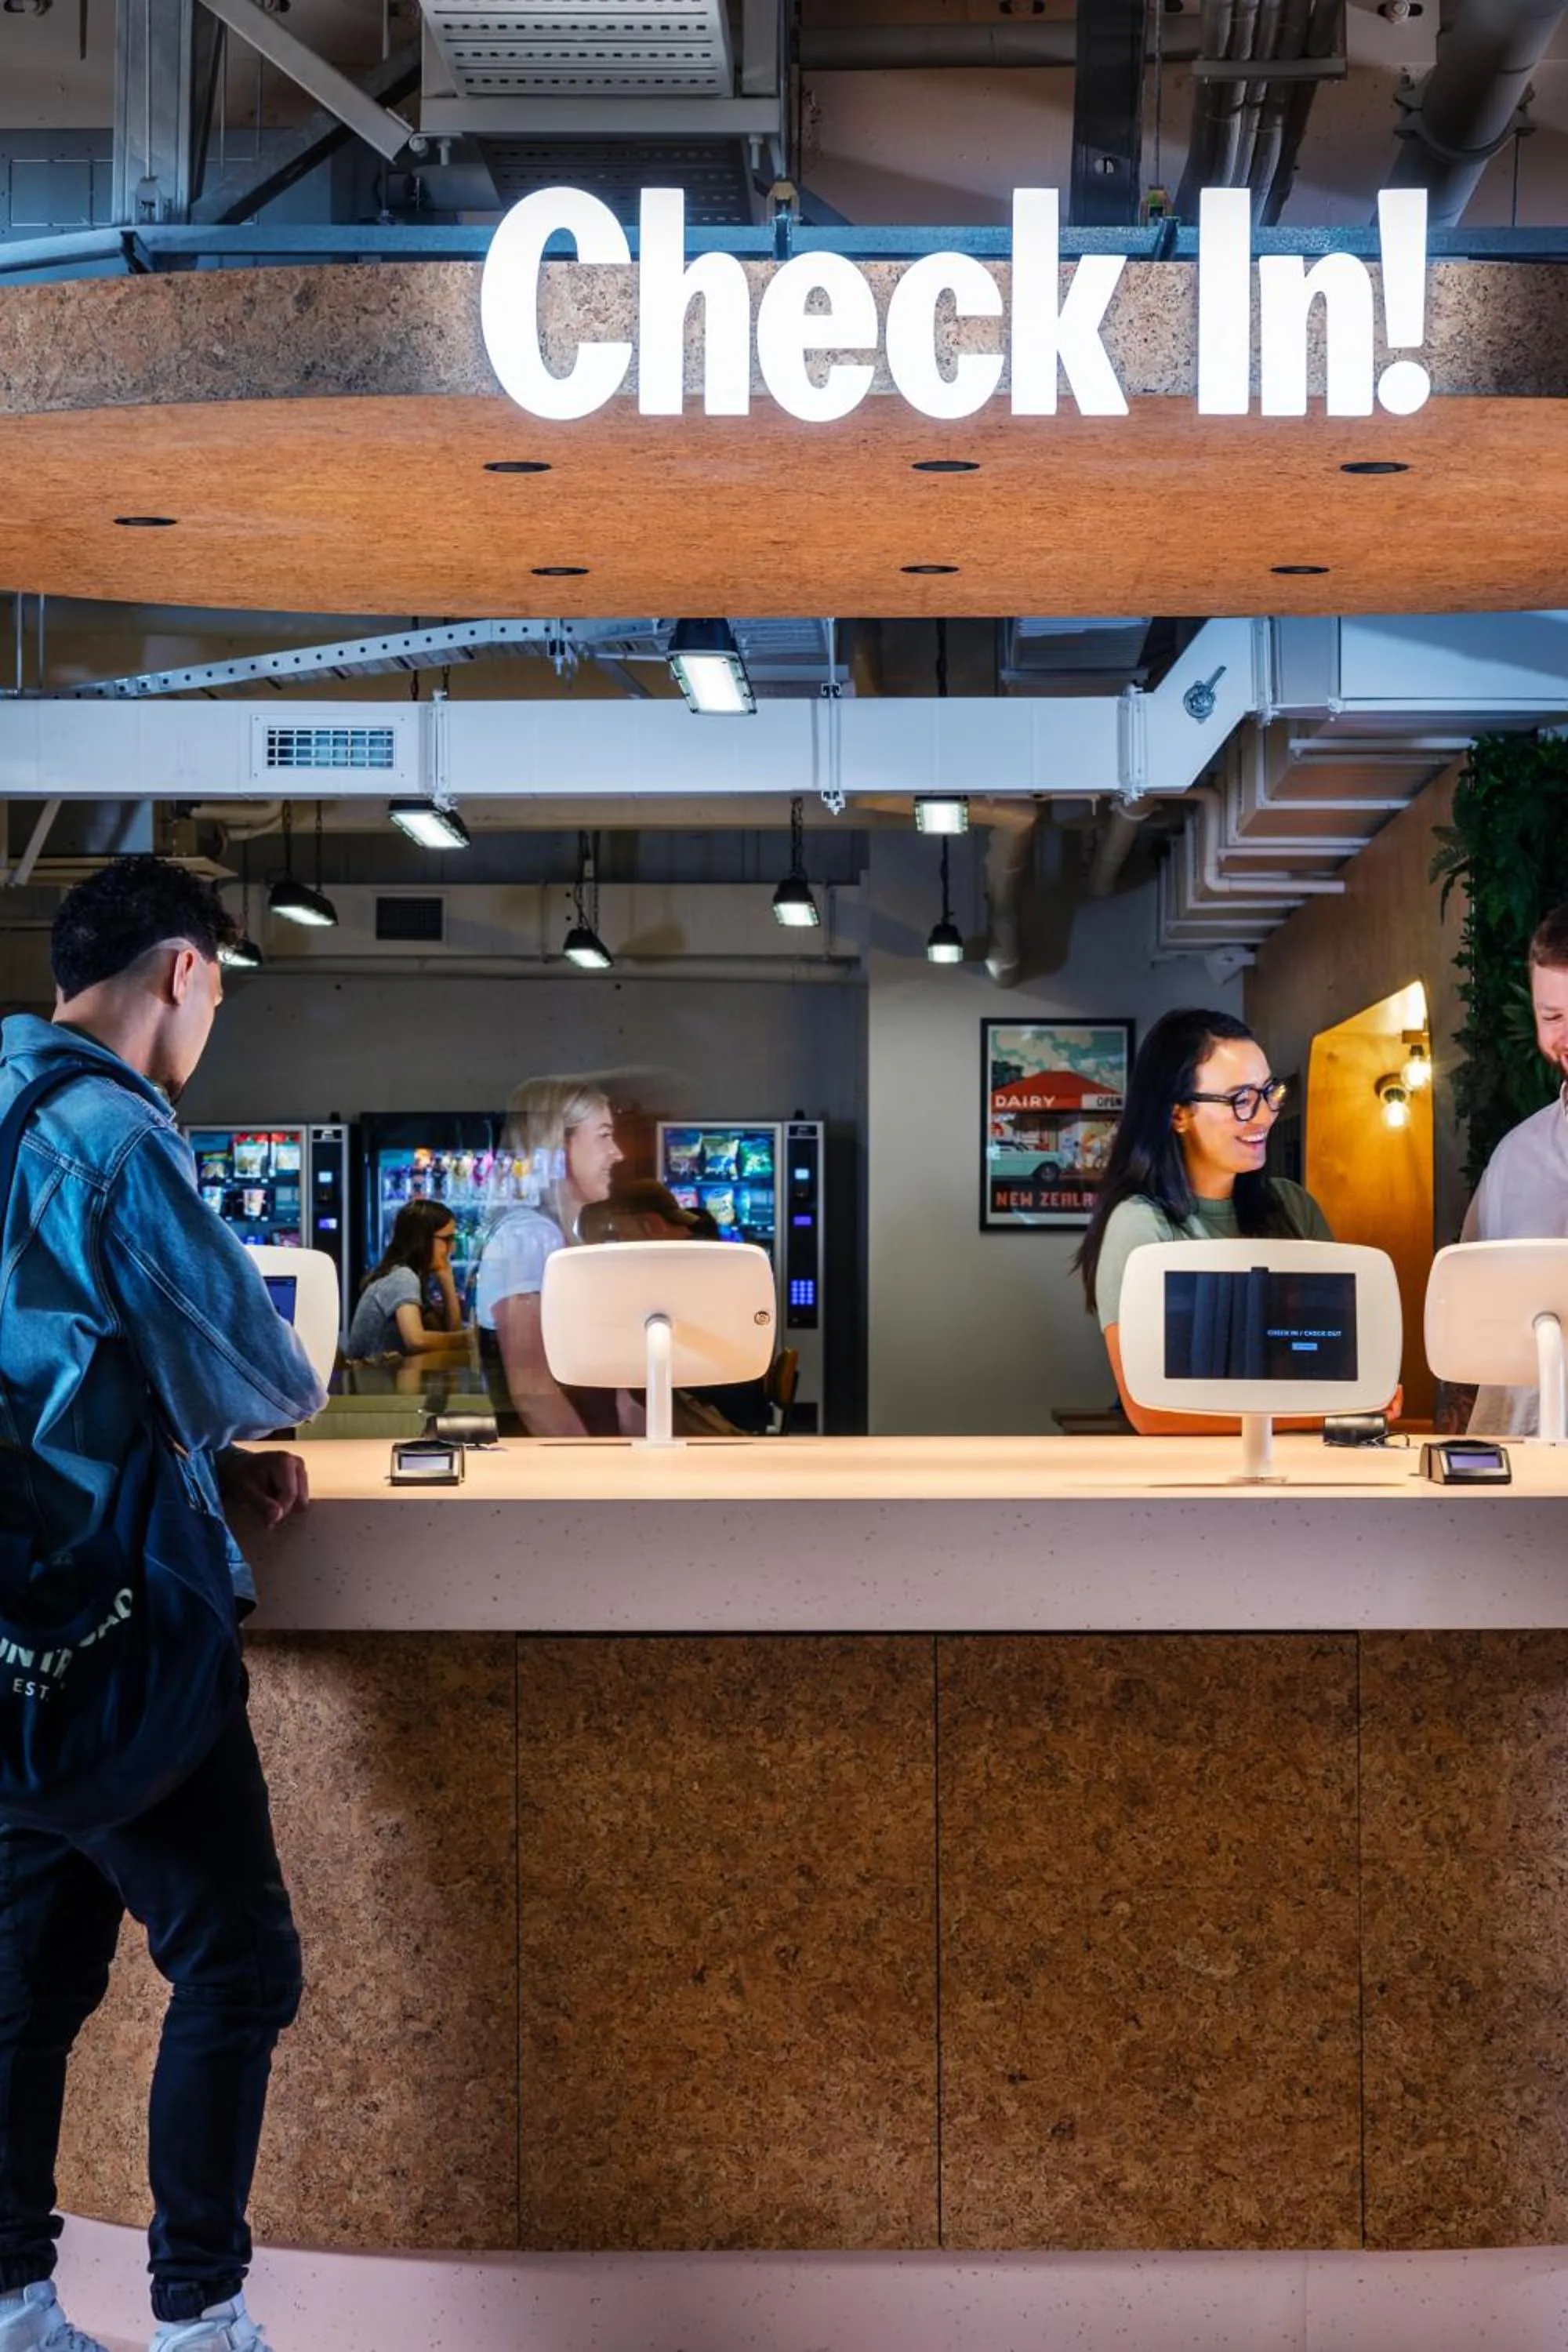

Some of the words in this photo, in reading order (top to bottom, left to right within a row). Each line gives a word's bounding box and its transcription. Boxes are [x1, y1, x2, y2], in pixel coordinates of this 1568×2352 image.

[481, 187, 1129, 422] Check
[1198, 188, 1431, 416] In!
[995, 1095, 1055, 1108] DAIRY
[996, 1191, 1033, 1207] NEW
